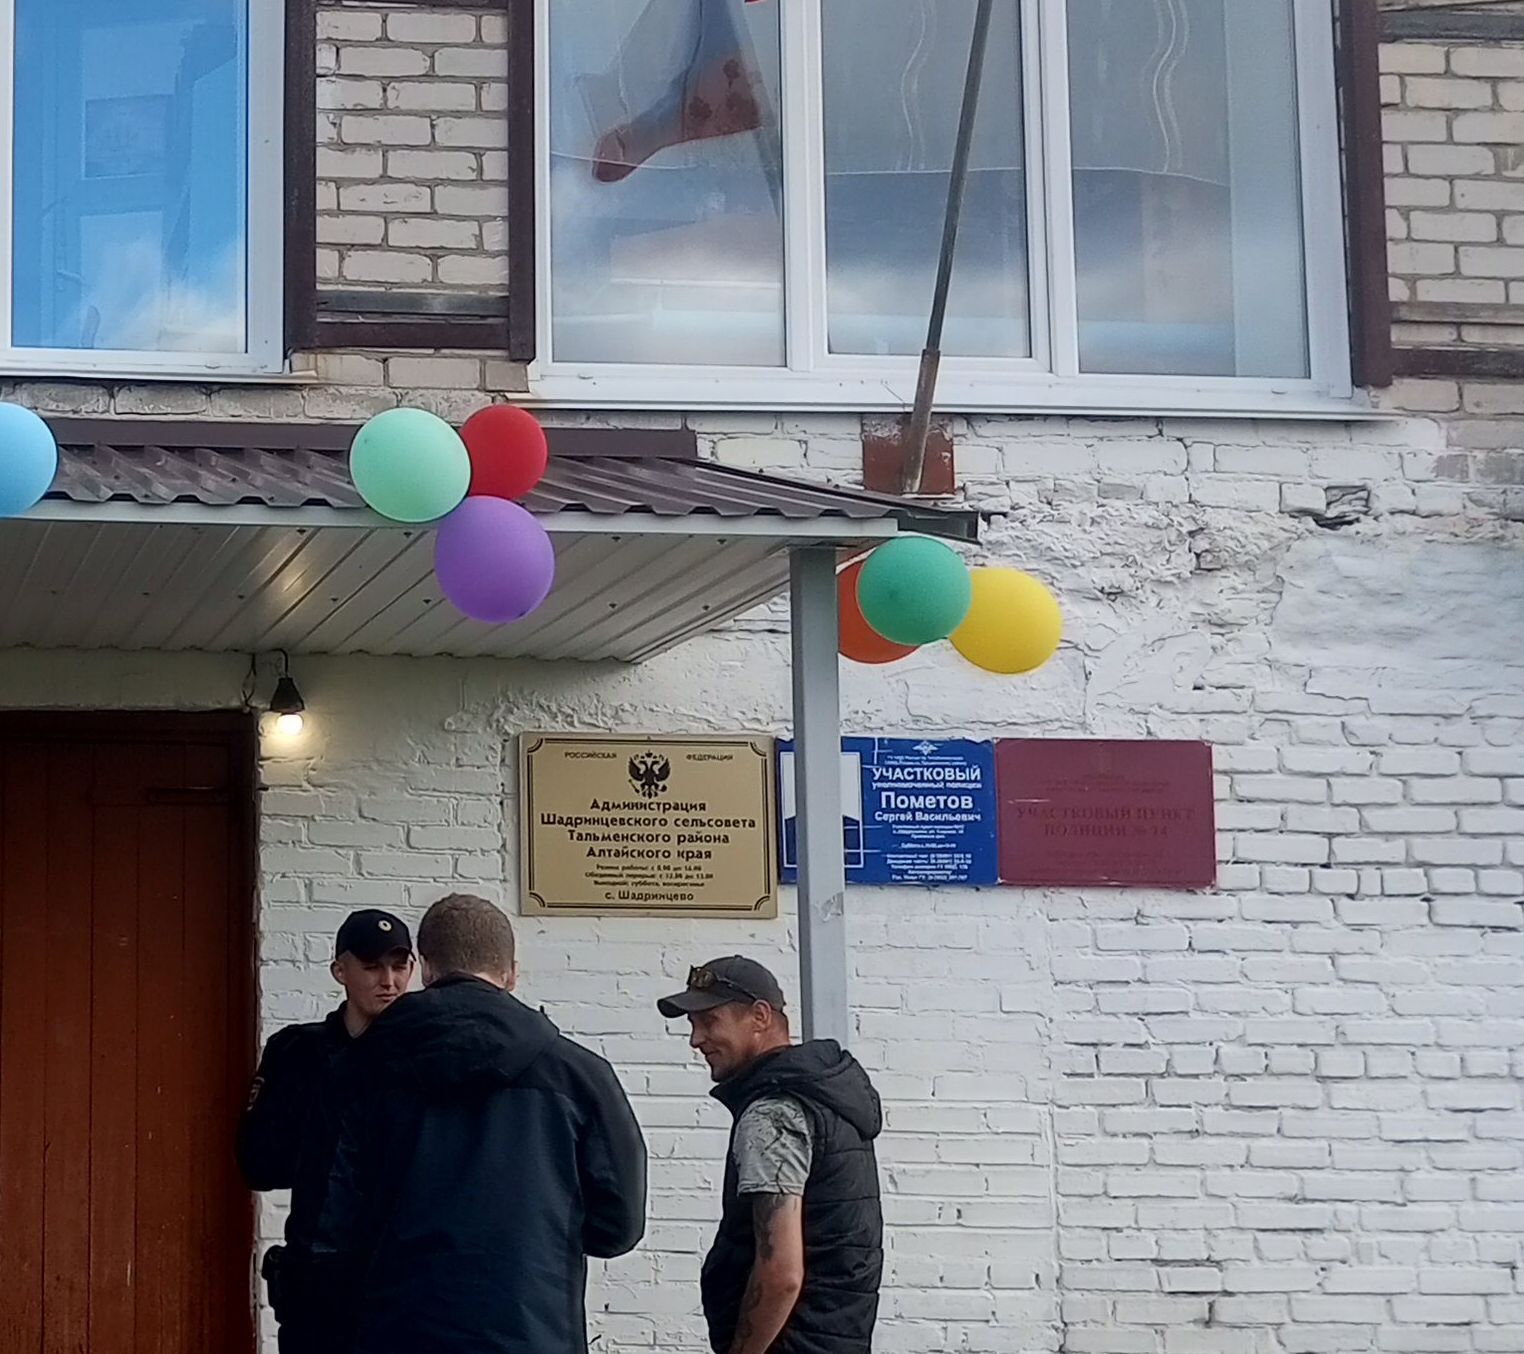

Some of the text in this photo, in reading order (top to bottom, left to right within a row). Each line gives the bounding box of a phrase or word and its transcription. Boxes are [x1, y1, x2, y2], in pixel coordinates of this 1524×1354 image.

[564, 750, 617, 759] РОССИЙСКАЯ
[872, 765, 981, 780] УЧАСТКОВЫЙ
[589, 798, 706, 813] Администрация
[881, 791, 973, 809] Пометов
[541, 813, 756, 828] Шадринцевского сельсовета
[874, 811, 981, 823] Сергей Васильевич
[568, 829, 730, 845] Тальменского района
[586, 846, 712, 861] Алтайского края
[618, 891, 694, 902] Шадринцево
